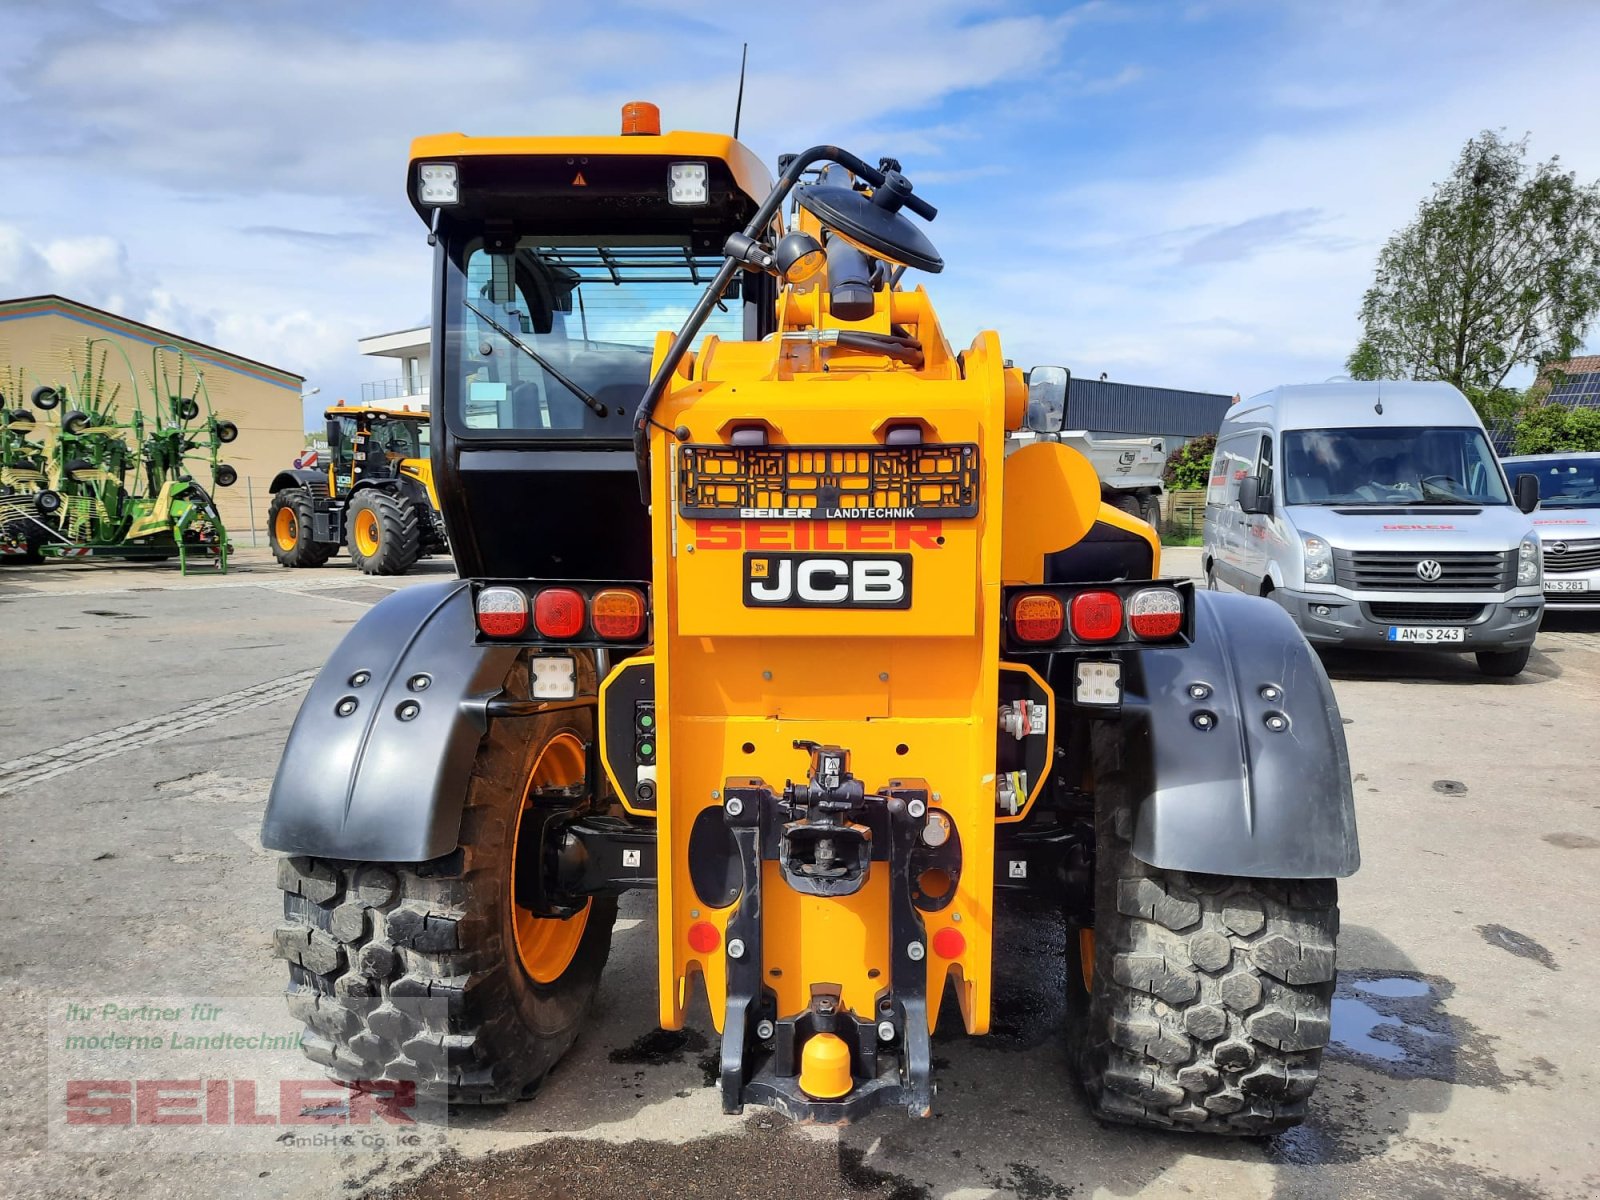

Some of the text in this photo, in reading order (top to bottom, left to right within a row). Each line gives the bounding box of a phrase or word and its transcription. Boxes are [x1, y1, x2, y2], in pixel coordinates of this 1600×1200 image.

[740, 508, 915, 519] SEILER LANDTECHNIK
[696, 519, 942, 549] SEILER
[750, 559, 904, 603] JCB
[1565, 581, 1585, 590] 281
[1401, 628, 1459, 640] AN S 243
